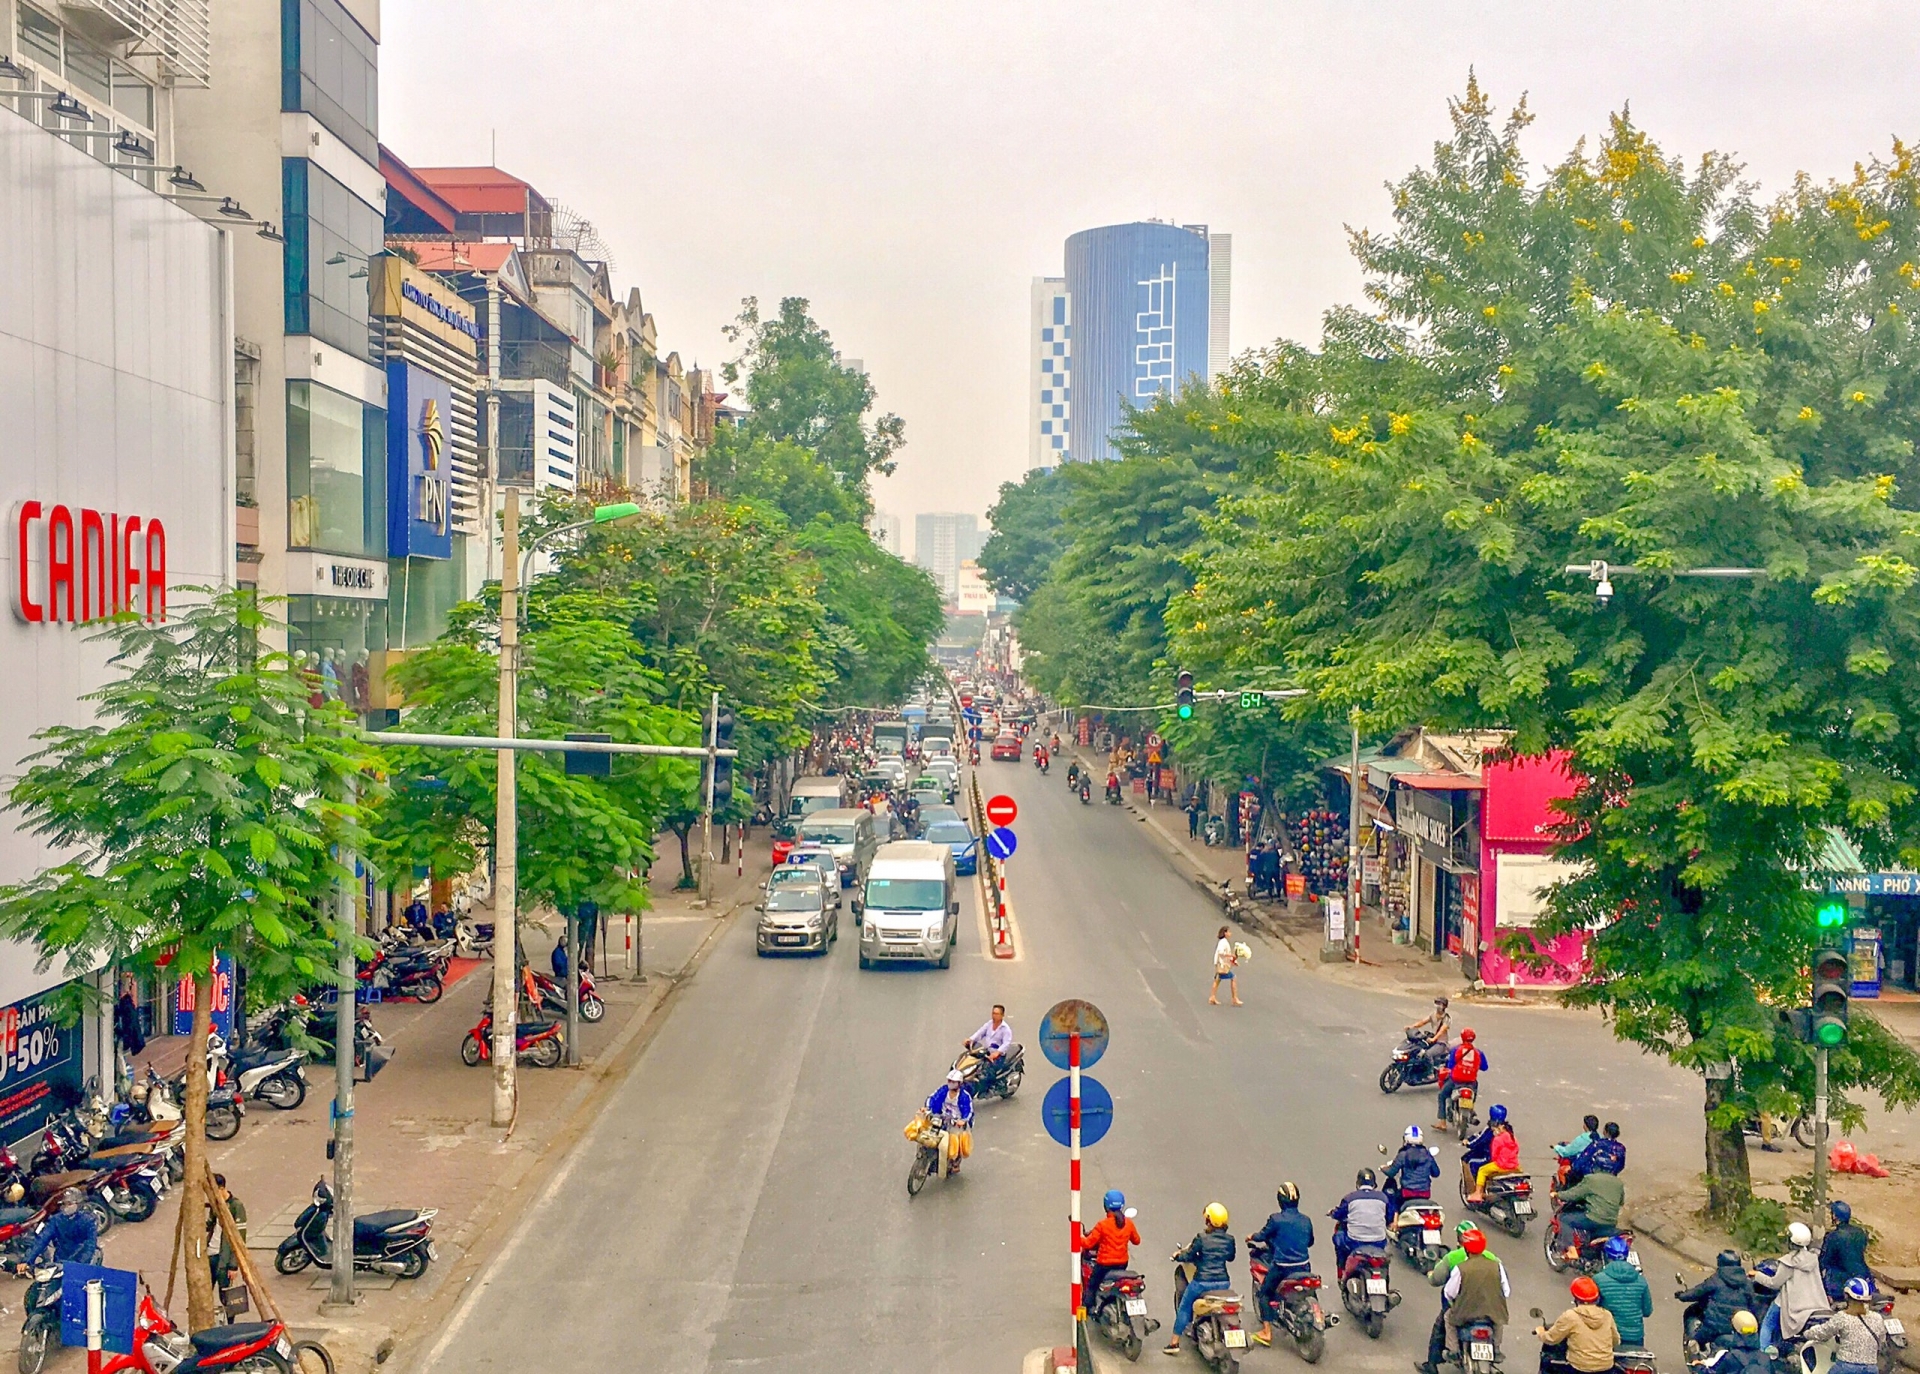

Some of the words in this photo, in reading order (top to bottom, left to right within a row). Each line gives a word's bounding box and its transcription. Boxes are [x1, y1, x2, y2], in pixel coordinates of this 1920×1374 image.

[423, 475, 447, 536] PNJ
[17, 500, 166, 623] CANIFA
[1241, 693, 1260, 708] 64
